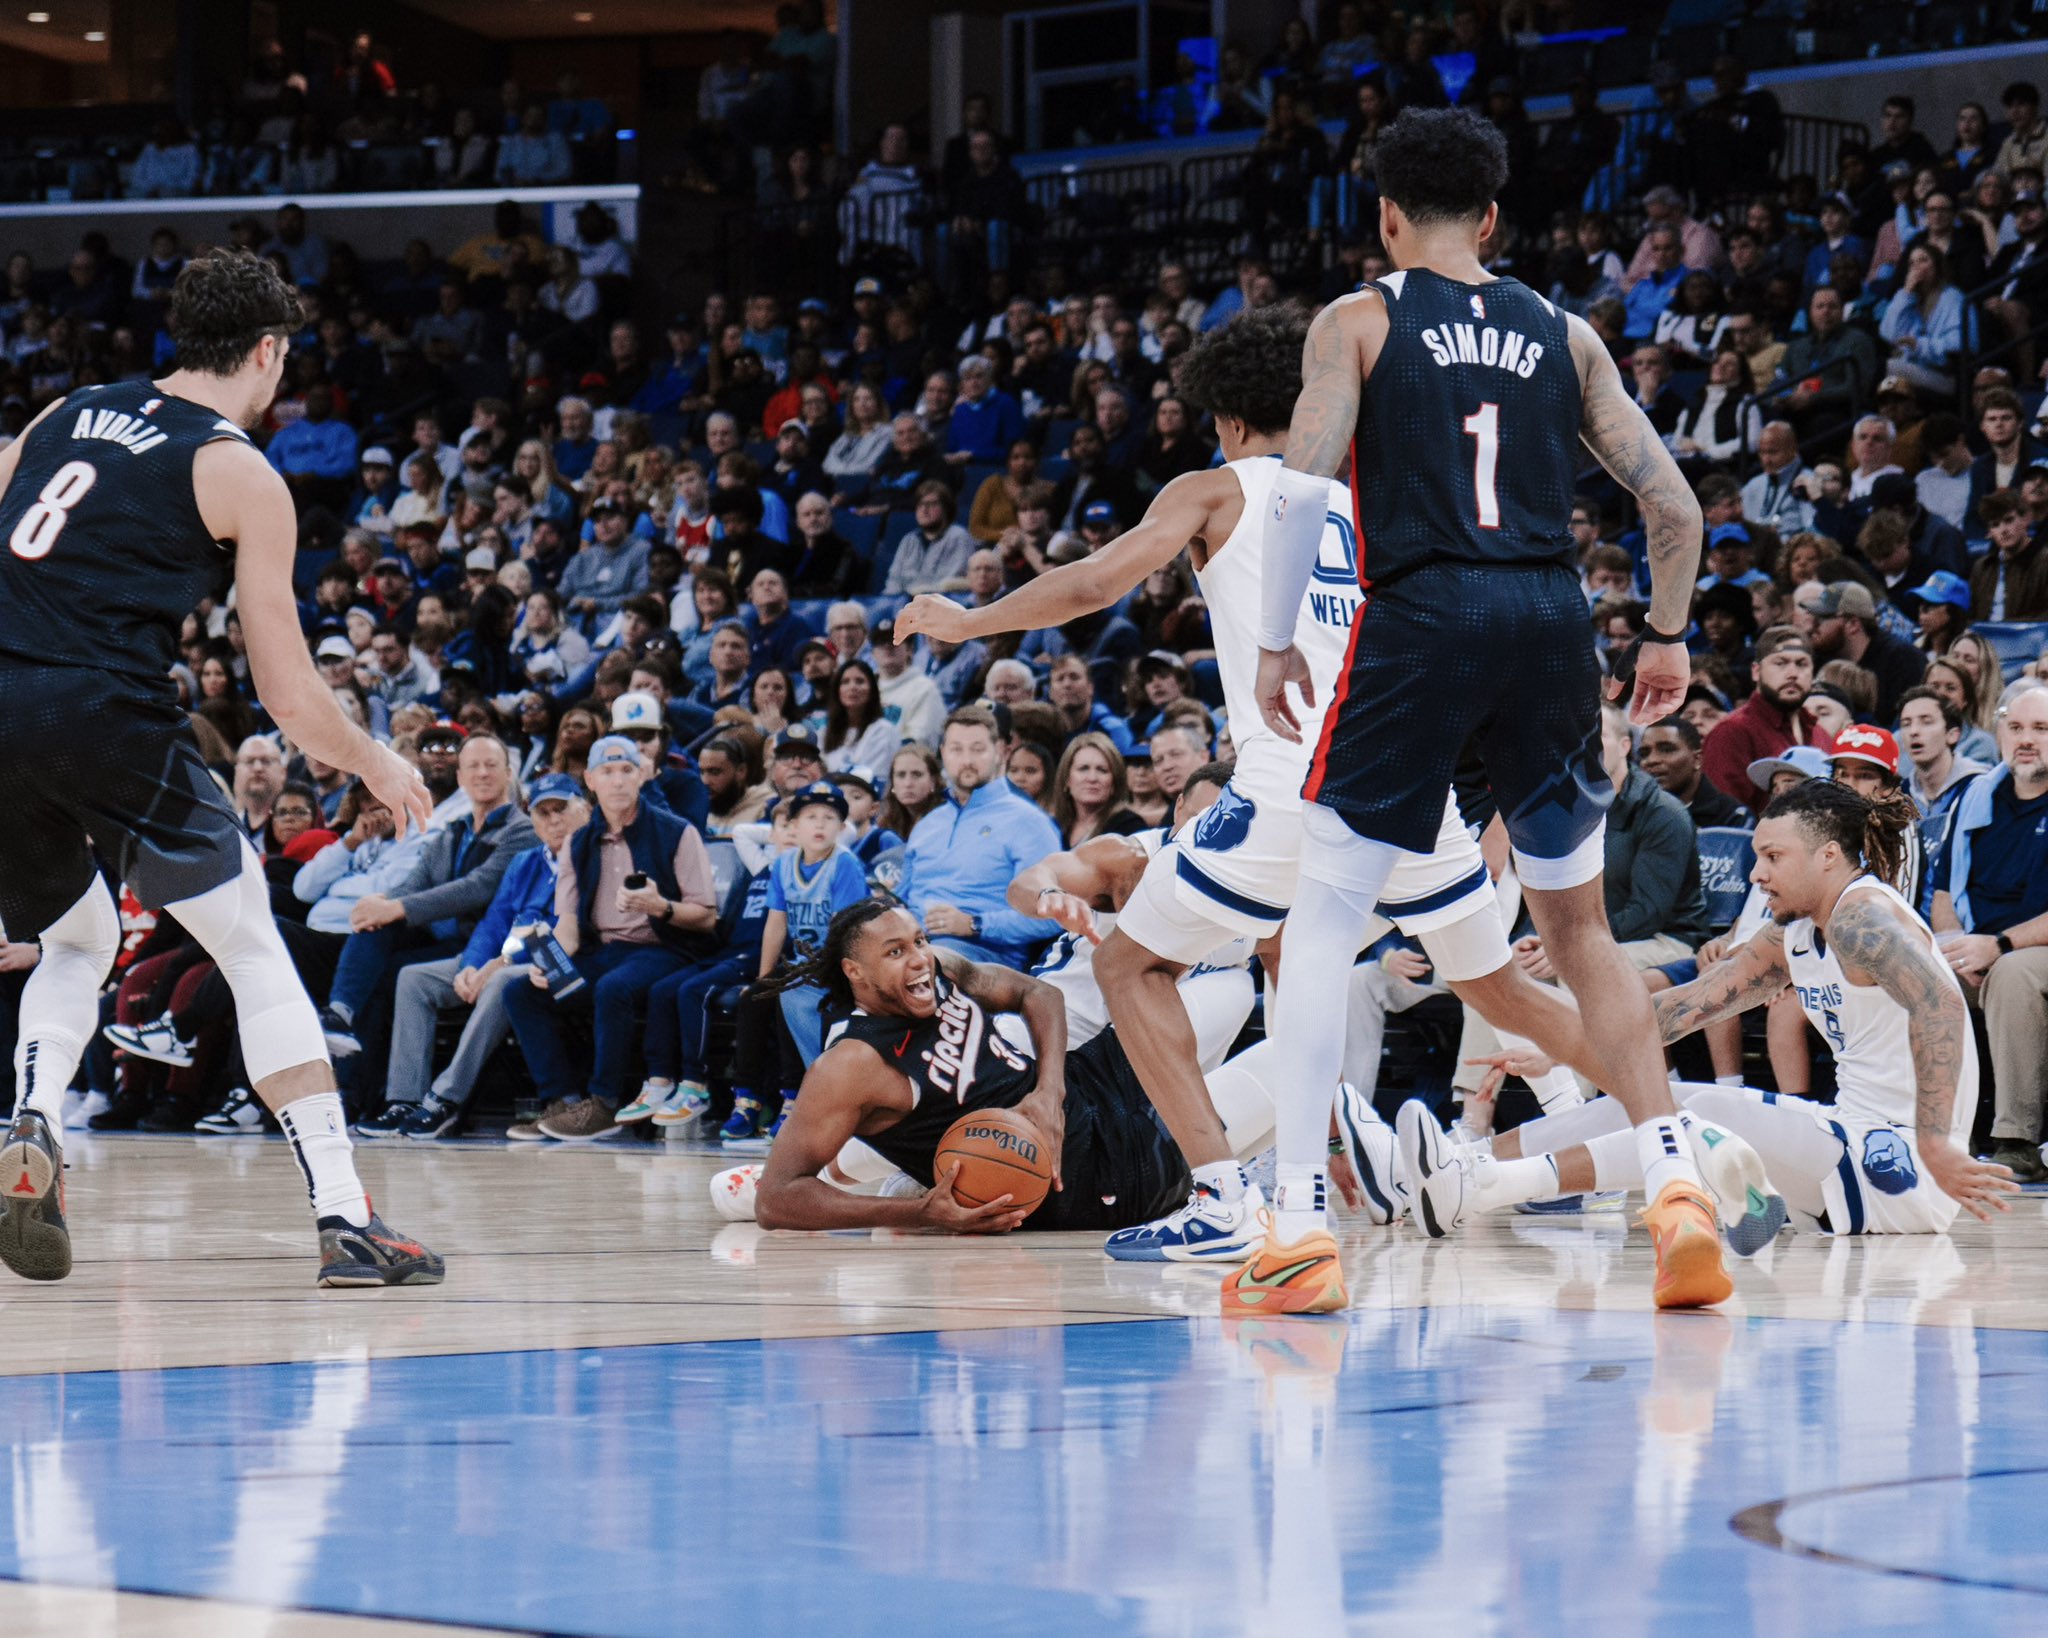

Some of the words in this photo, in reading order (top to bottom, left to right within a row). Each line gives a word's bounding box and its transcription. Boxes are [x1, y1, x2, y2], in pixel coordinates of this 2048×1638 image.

[1421, 322, 1545, 379] SIMONS
[71, 408, 169, 455] AVDIJA
[1463, 401, 1500, 529] 1
[8, 460, 98, 561] 8
[920, 982, 985, 1106] ripcity
[988, 1032, 1028, 1072] 3
[964, 1126, 1039, 1165] Wilson
